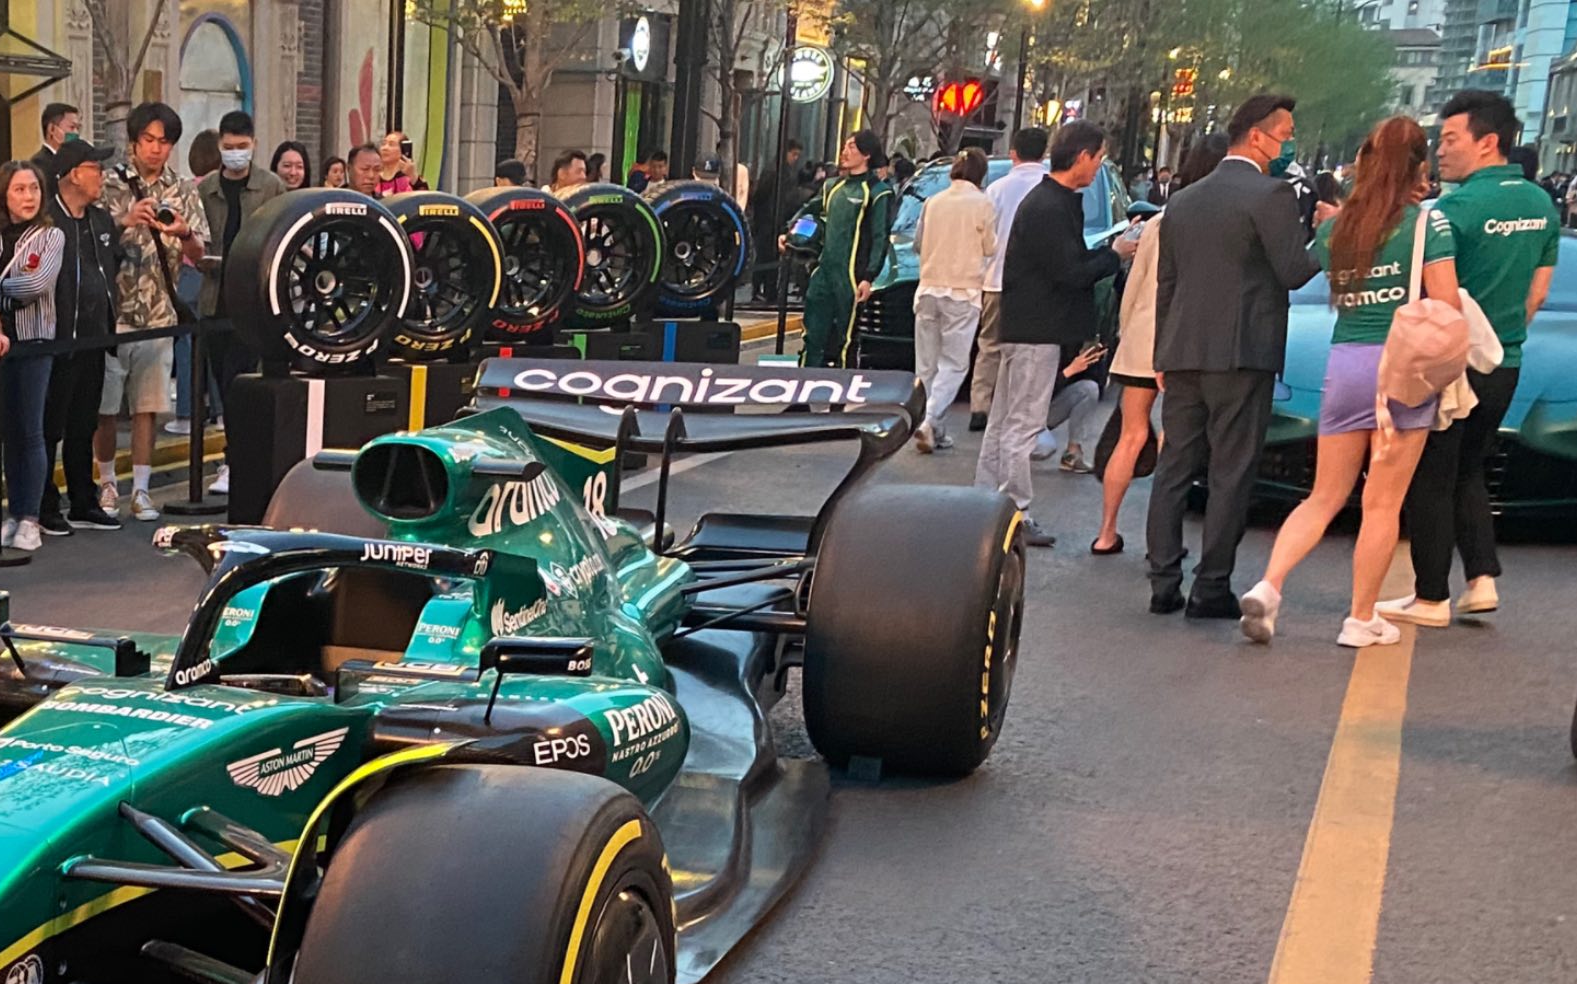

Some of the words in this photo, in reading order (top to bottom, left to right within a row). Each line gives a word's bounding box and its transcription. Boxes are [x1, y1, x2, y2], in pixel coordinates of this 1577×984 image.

[326, 202, 367, 215] PIRELLI
[419, 204, 459, 216] PIRELLI
[1484, 217, 1547, 236] Cognizant
[394, 333, 455, 350] ZERO
[298, 347, 360, 364] ZERO
[513, 368, 872, 413] cognizant
[583, 470, 617, 540] 18
[222, 607, 255, 617] ERONI
[418, 622, 460, 636] PERONI
[175, 659, 212, 686] aramco
[55, 686, 256, 715] cognizant
[41, 702, 214, 729] BOMBARDIER
[603, 692, 676, 747] PERONI
[12, 740, 65, 752] Porto
[64, 745, 140, 767] Seguro
[261, 755, 285, 774] ASTON
[285, 747, 314, 765] MARTIN
[534, 733, 590, 765] EPOS
